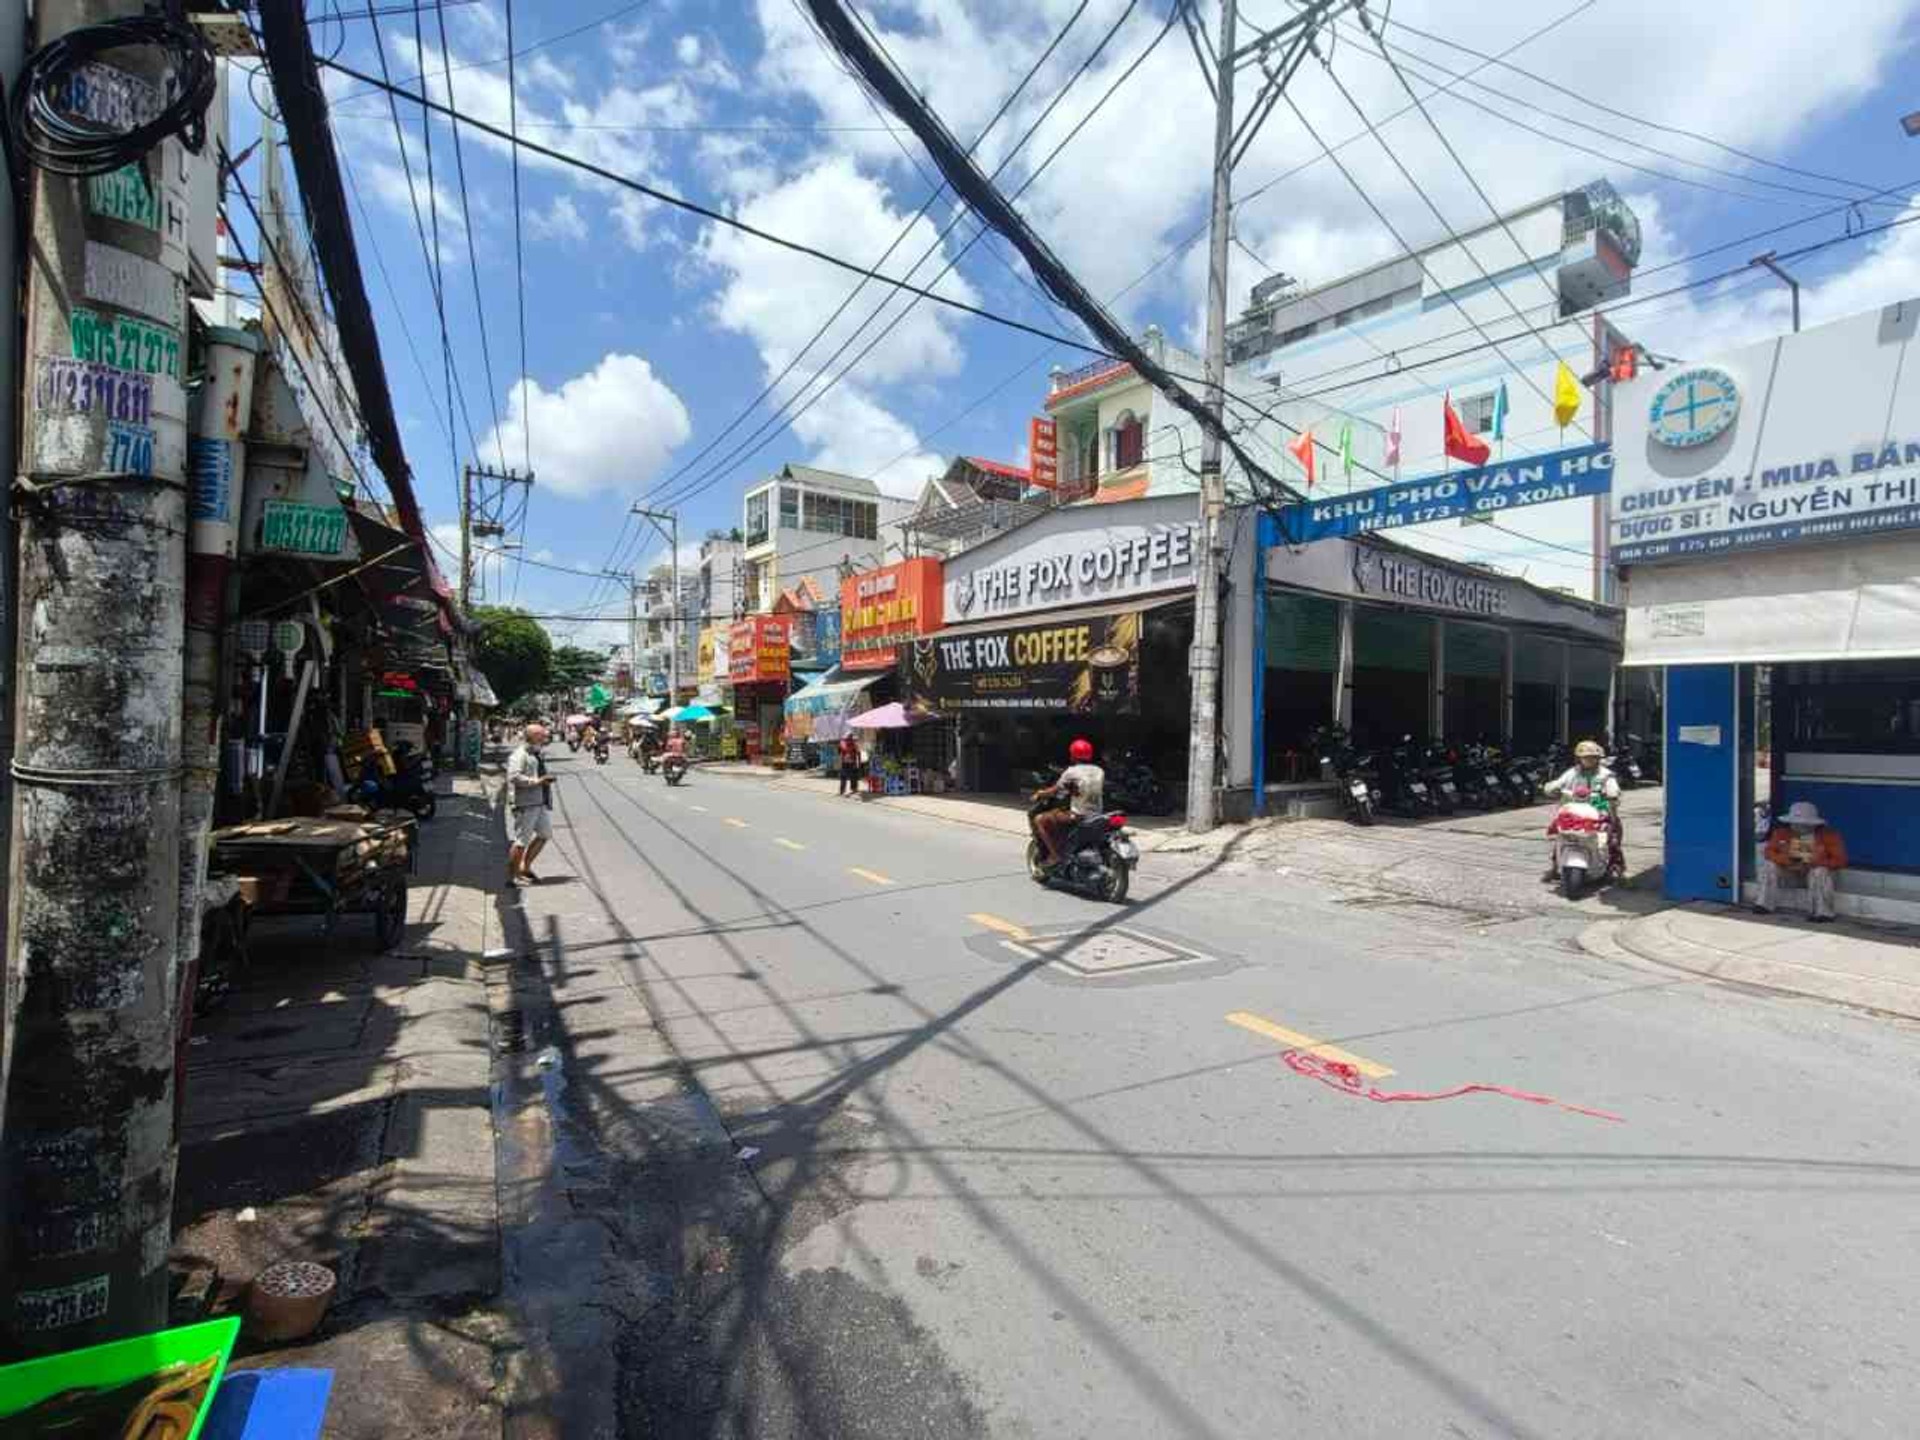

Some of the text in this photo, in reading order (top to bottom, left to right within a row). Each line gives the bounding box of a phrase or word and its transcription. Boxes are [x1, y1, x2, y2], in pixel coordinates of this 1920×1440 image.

[1313, 501, 1375, 522] KHU
[1389, 475, 1459, 506] PHỐ
[1620, 477, 1733, 512] CHUYÊN
[1761, 459, 1838, 488] MUA
[1728, 487, 1852, 524] NGUYỄN
[1864, 477, 1916, 504] THỊ
[1413, 506, 1450, 525] 173
[980, 527, 1192, 602] THE FOX COFFEE
[1380, 558, 1511, 617] THE FOX COFFEE
[940, 625, 1091, 671] THE FOX COFFEE
